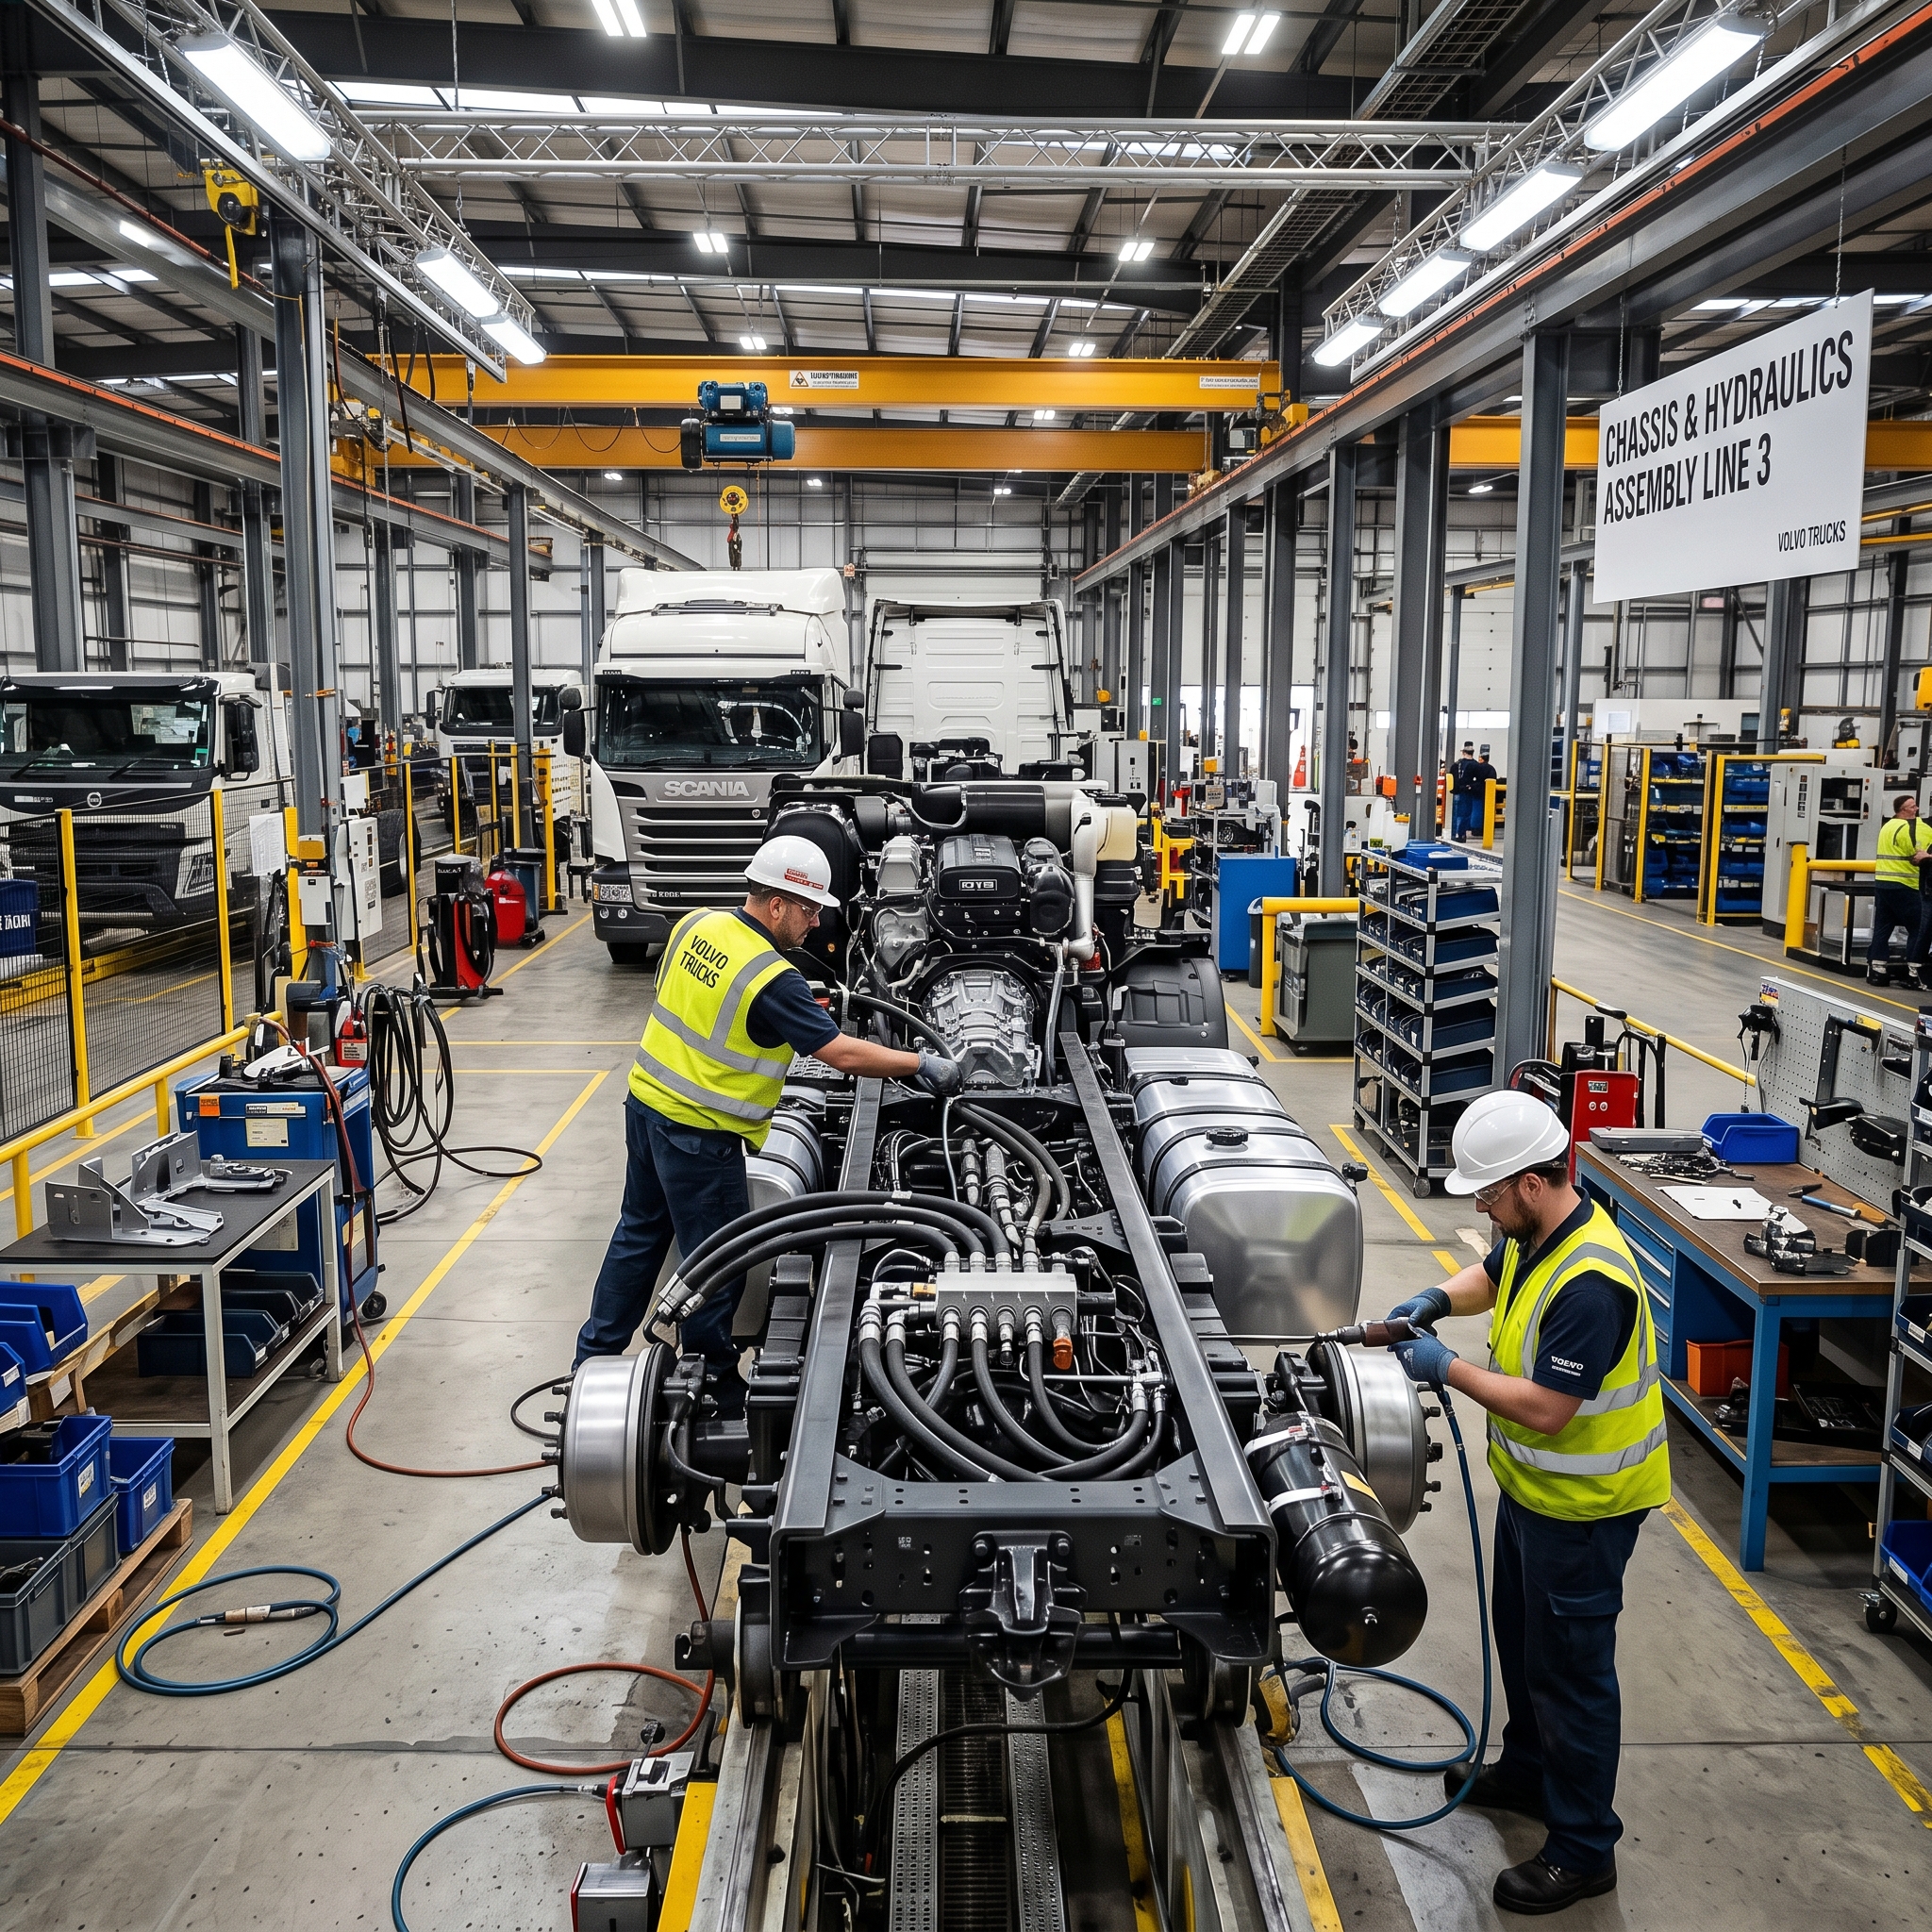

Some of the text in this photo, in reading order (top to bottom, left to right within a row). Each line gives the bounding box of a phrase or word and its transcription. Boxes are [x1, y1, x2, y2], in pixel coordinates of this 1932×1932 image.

[1606, 329, 1854, 468] CHASSIS & HYDRAULICS
[1603, 432, 1772, 525] ASSEMBLY LINE 3
[1777, 520, 1846, 553] VOLVO TRUCKS
[664, 780, 750, 797] SCANIA
[679, 950, 721, 989] TRUCKS
[691, 935, 729, 970] VOLVO
